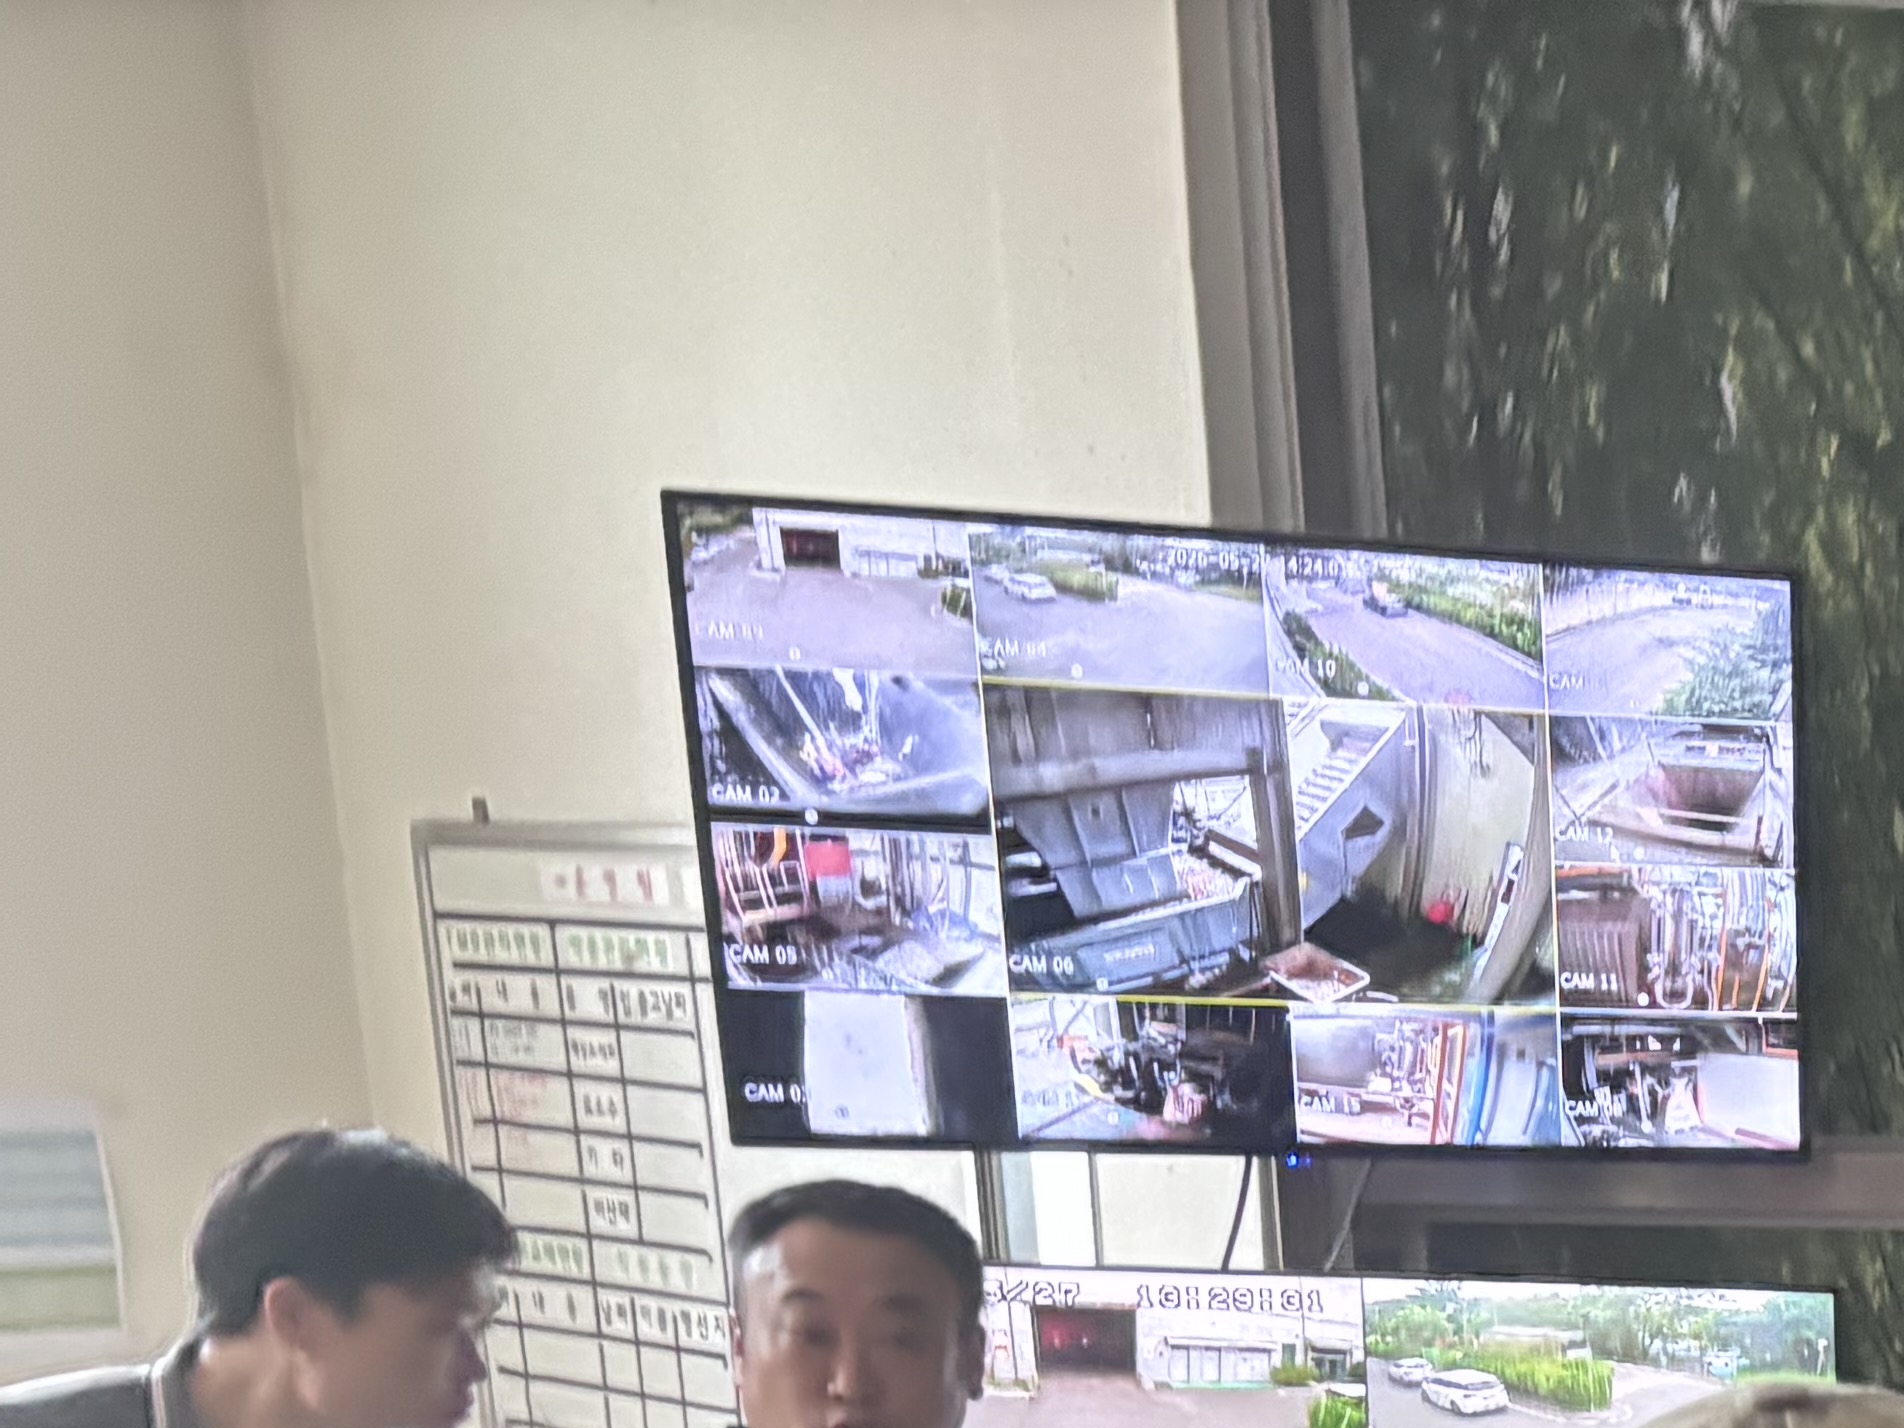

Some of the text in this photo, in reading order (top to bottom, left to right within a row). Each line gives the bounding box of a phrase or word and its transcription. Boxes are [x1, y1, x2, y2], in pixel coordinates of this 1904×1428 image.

[711, 783, 752, 803] CAM
[1556, 826, 1588, 841] CAM
[730, 943, 769, 964] CAM
[1009, 954, 1047, 973] CAM
[1560, 971, 1618, 991] CAM 11
[744, 1082, 784, 1102] CAM
[1302, 1095, 1335, 1112] CAM
[1565, 1100, 1599, 1117] CAM
